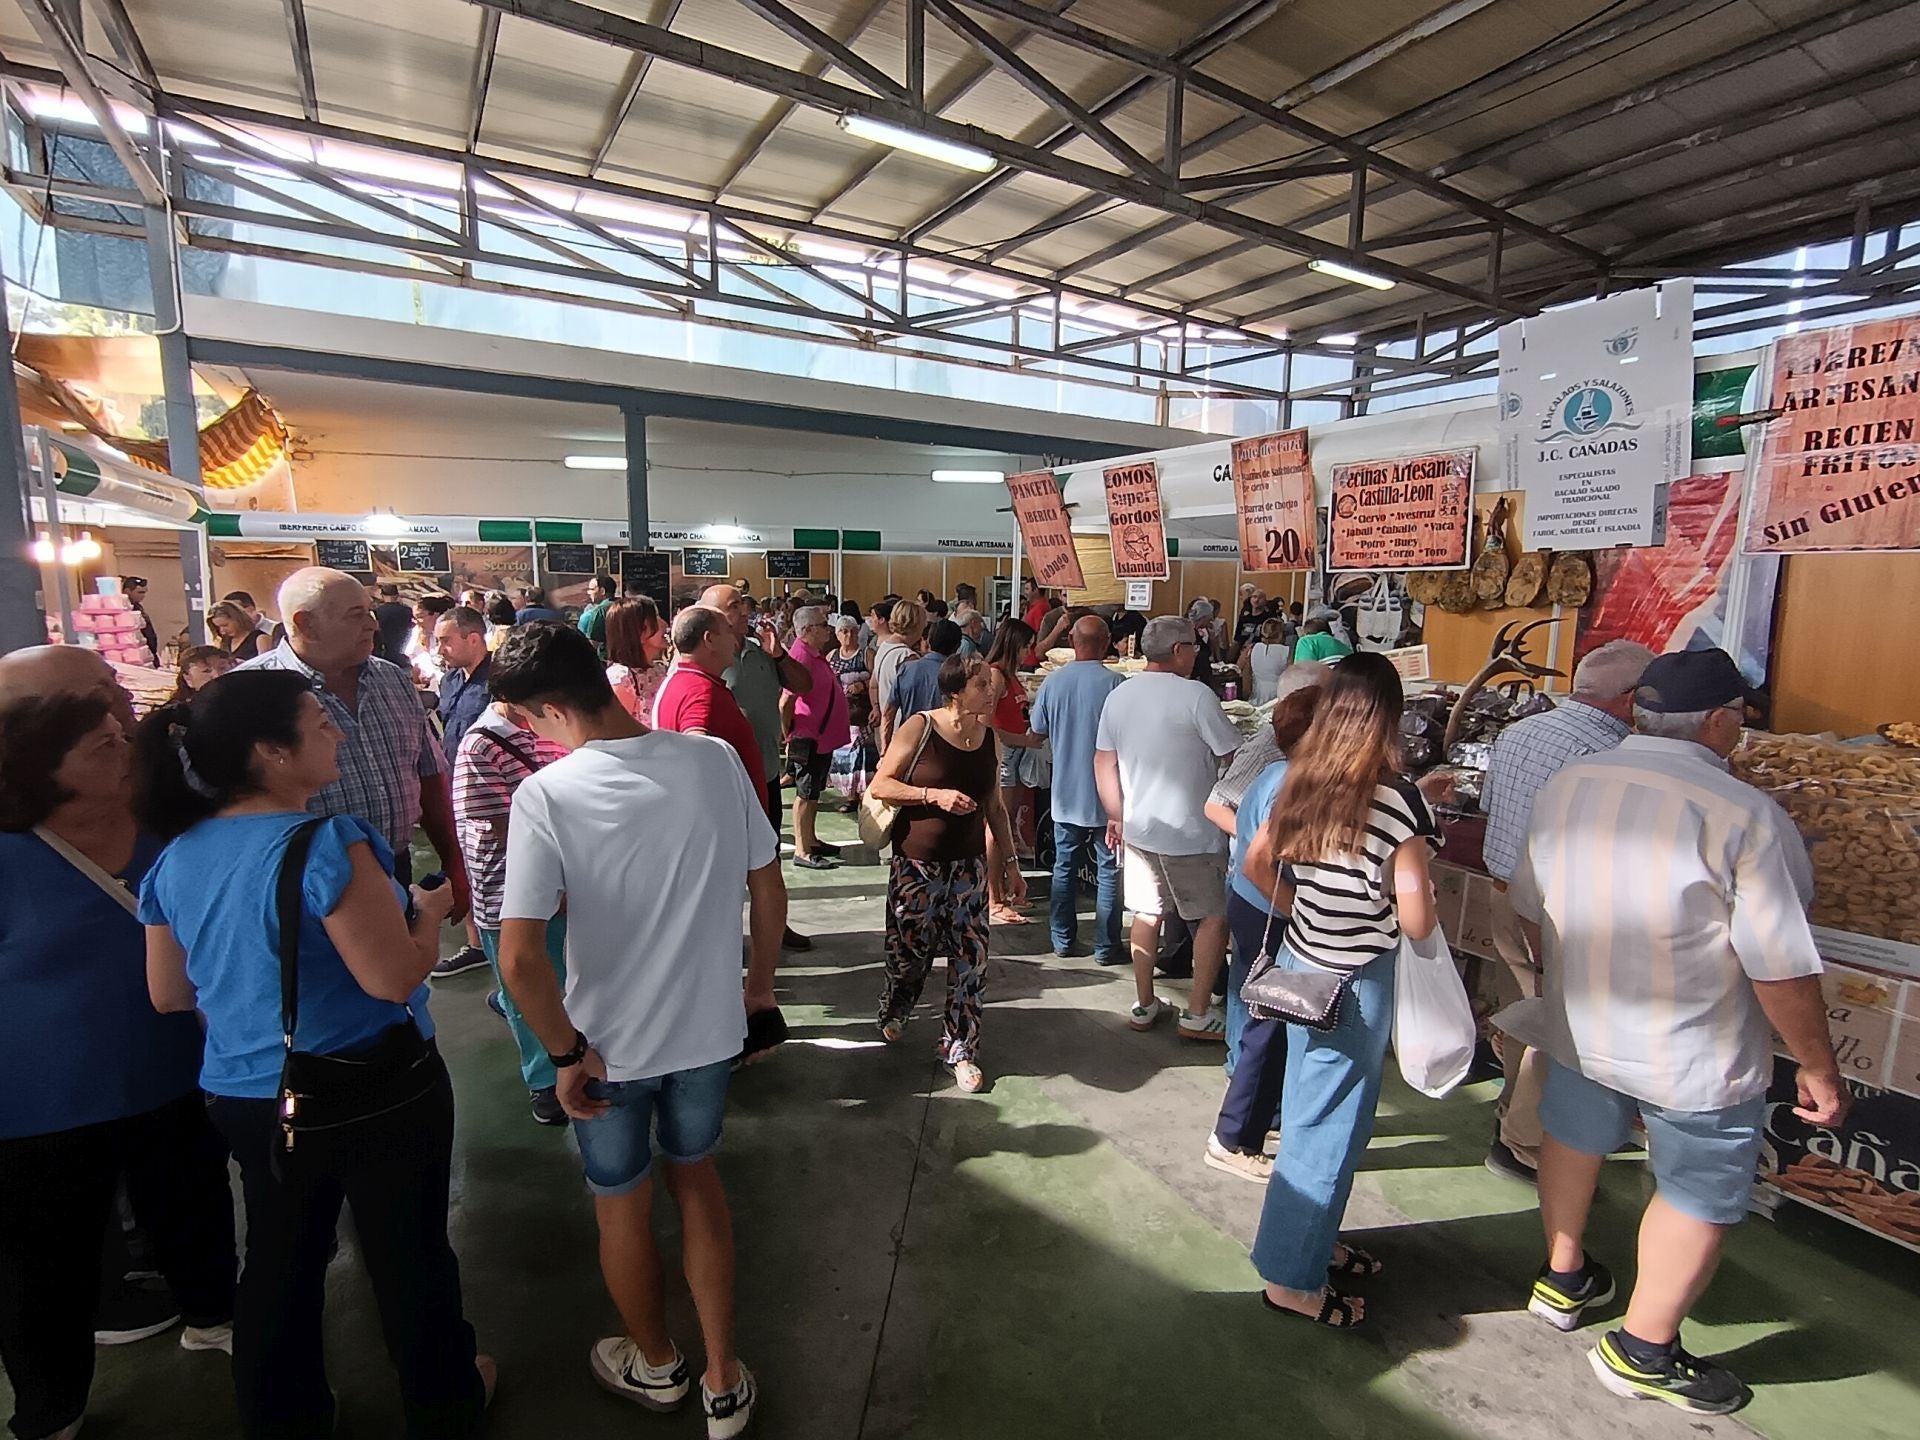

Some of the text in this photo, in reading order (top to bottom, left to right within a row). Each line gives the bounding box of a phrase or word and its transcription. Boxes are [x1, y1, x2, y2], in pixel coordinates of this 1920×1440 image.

[1786, 336, 1920, 380] ORREZN
[1782, 371, 1920, 413] ARTESAN
[1540, 383, 1581, 430] BACALAOS
[1583, 380, 1592, 388] Y
[1592, 379, 1635, 417] SALAZONES
[1802, 419, 1914, 452] RECIEN
[1538, 438, 1638, 462] J.C. CAÑADAS
[1802, 447, 1918, 477] FRITOS
[1106, 469, 1154, 489] LOMOS
[1559, 468, 1616, 481] ESPECIALISTAS
[1011, 480, 1057, 500] PANCETA
[1360, 483, 1433, 507] Castilla-Leon
[1554, 484, 1620, 497] BACALAO SALADO
[1112, 491, 1154, 507] Super
[1562, 493, 1611, 505] TRADICIONAL
[1244, 503, 1264, 514] Barras
[1265, 502, 1274, 511] de
[1537, 507, 1638, 521] IMPORTACIONES DIRECTAS
[1763, 473, 1920, 545] Sin Gluten
[1024, 508, 1058, 523] IBERICA
[1111, 509, 1159, 526] Gordos
[1358, 509, 1436, 523] Ciervo Avestruz
[1572, 518, 1597, 527] DESDE
[329, 524, 356, 532] CAMPO
[1381, 524, 1417, 535] Caballo
[1430, 522, 1454, 531] Vaca
[1560, 527, 1595, 536] NORUEGA
[1604, 524, 1641, 533] ISLANDIA
[938, 539, 974, 547] PASTELERIA
[1030, 534, 1067, 547] BELLOTA
[1265, 528, 1300, 564] 20
[1360, 538, 1419, 549] Potro Buey
[400, 545, 409, 558] 2
[1345, 547, 1447, 560] Ternera Corzo Toro
[483, 560, 531, 572] Secreto.
[1118, 562, 1164, 574] Islandia
